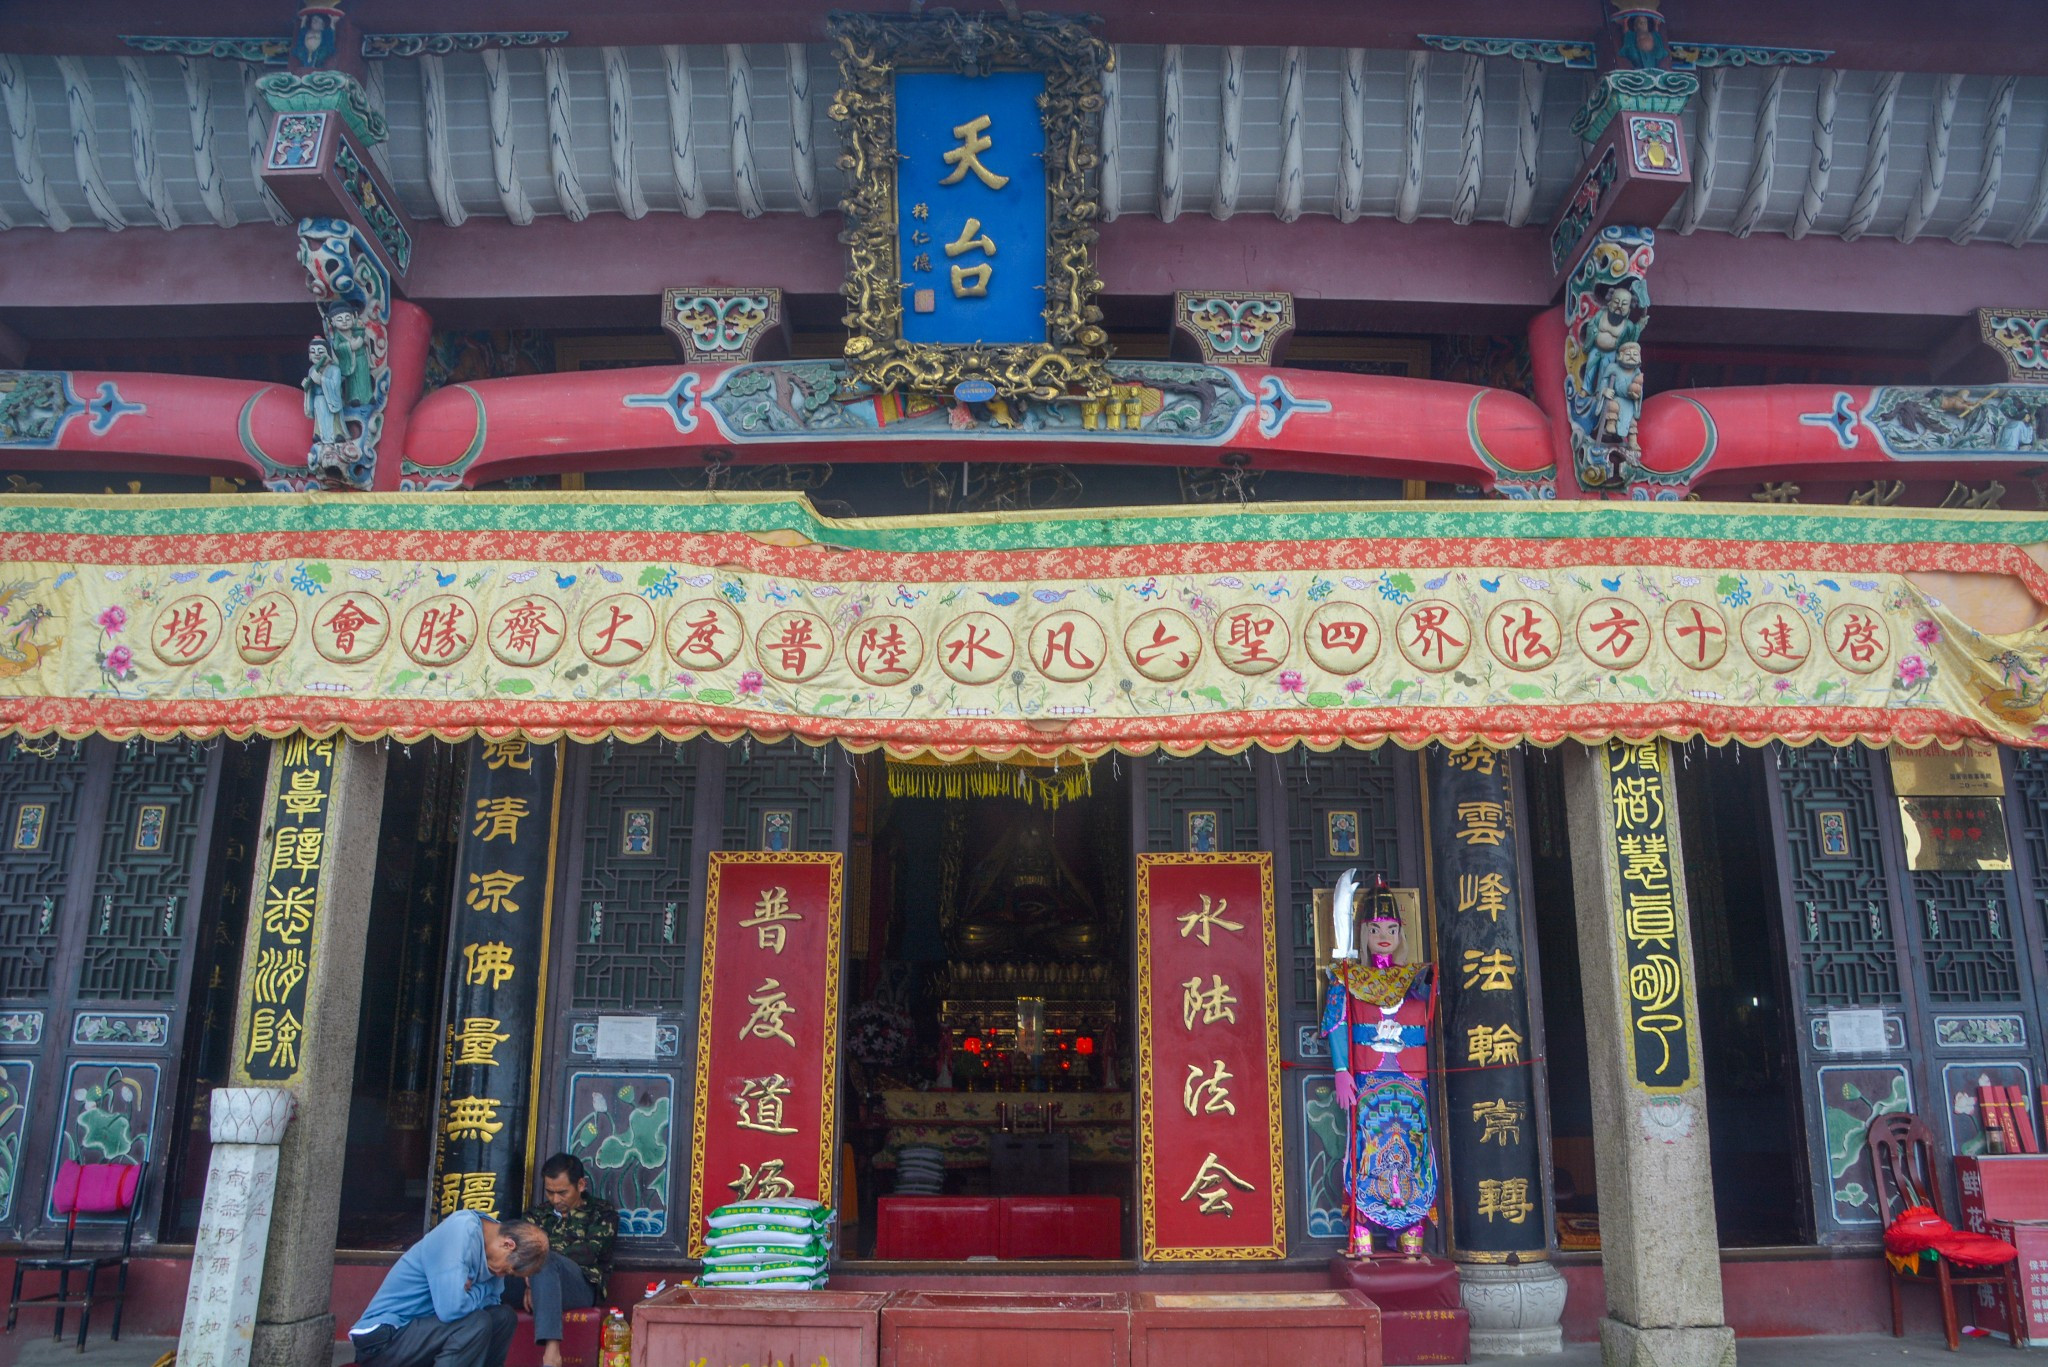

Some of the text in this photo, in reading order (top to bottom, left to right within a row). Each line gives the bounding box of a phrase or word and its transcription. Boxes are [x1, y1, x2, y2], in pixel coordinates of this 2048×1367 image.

[938, 114, 1010, 299] 天台
[727, 886, 803, 1200] 普度道场
[1176, 893, 1256, 1218] 水陆法会
